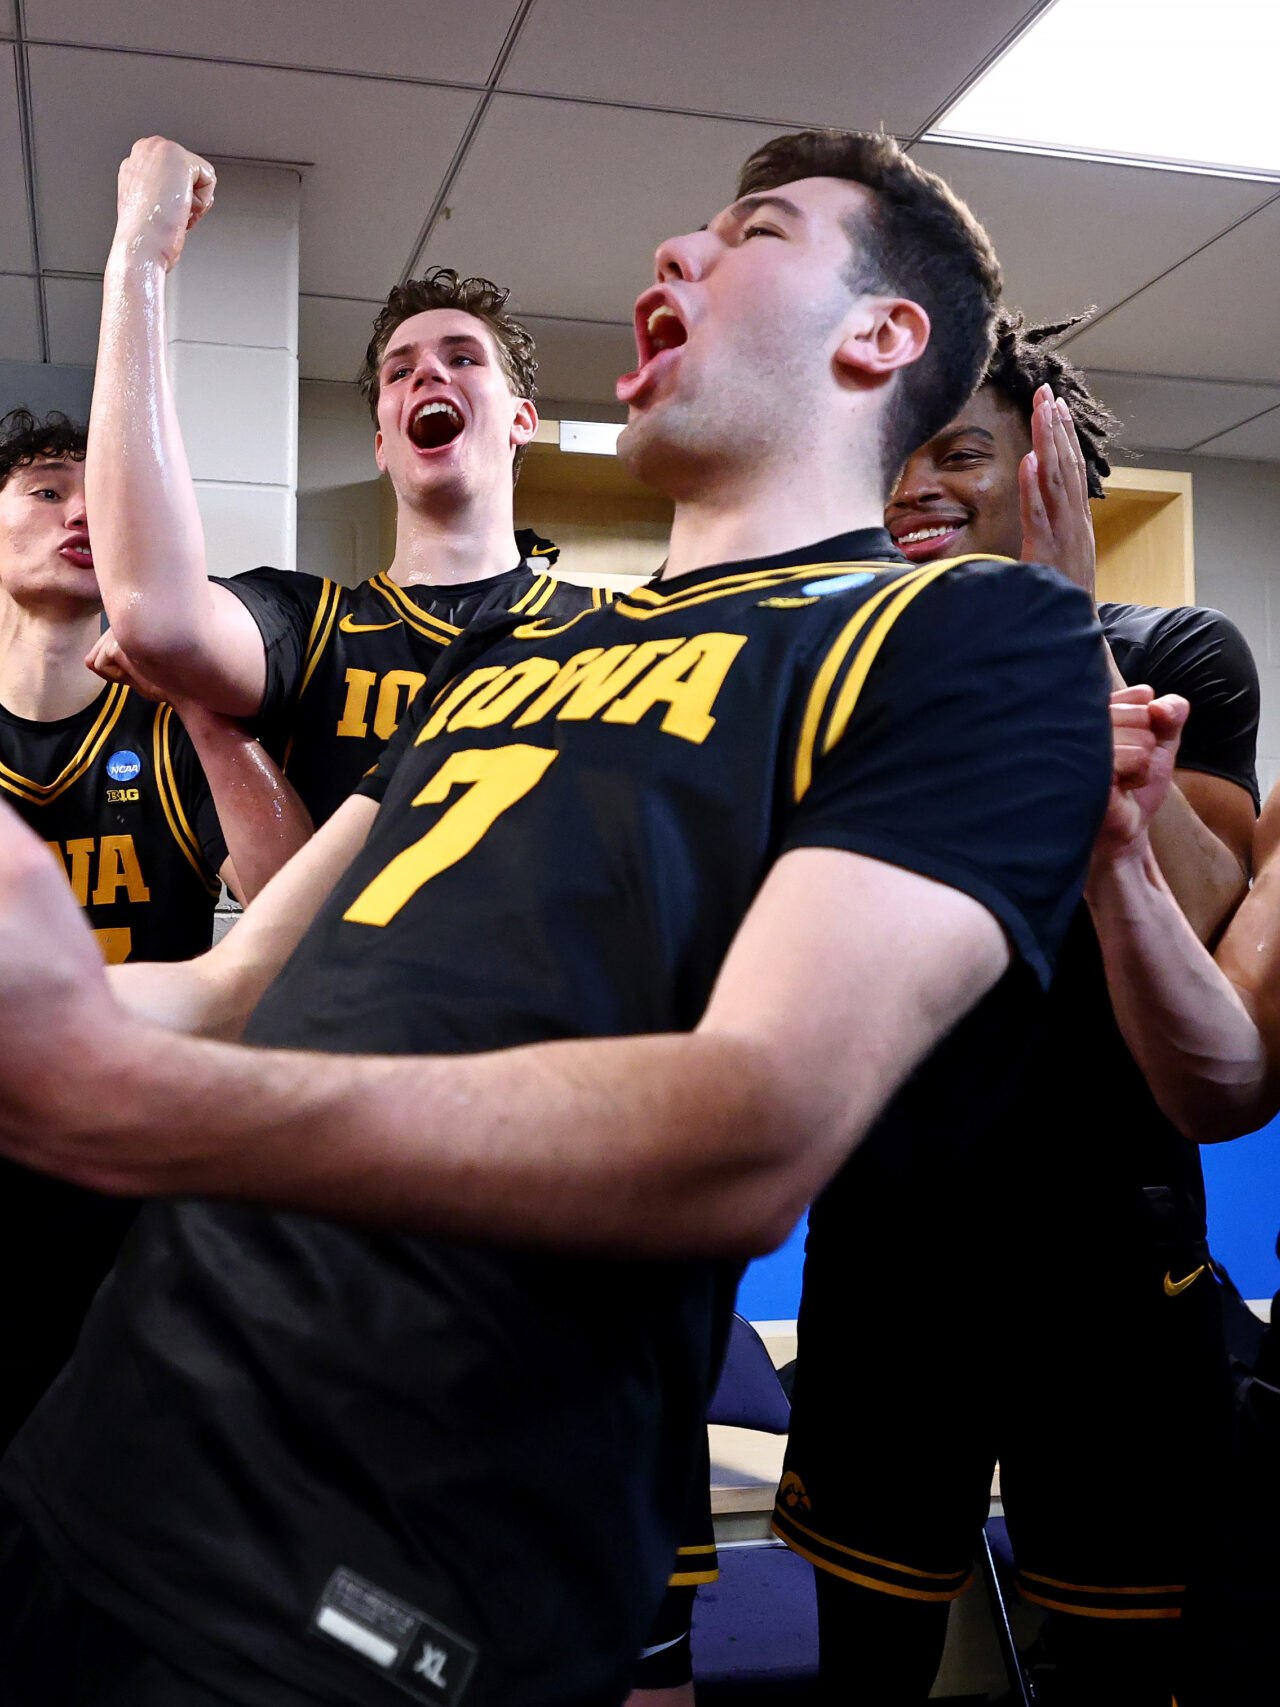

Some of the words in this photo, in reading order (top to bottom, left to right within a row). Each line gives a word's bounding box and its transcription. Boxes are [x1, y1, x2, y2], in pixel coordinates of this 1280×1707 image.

[336, 667, 427, 740] IO
[412, 632, 749, 746] IOWA
[111, 763, 140, 775] NCAA
[343, 743, 559, 927] 7
[412, 1640, 447, 1689] XL
